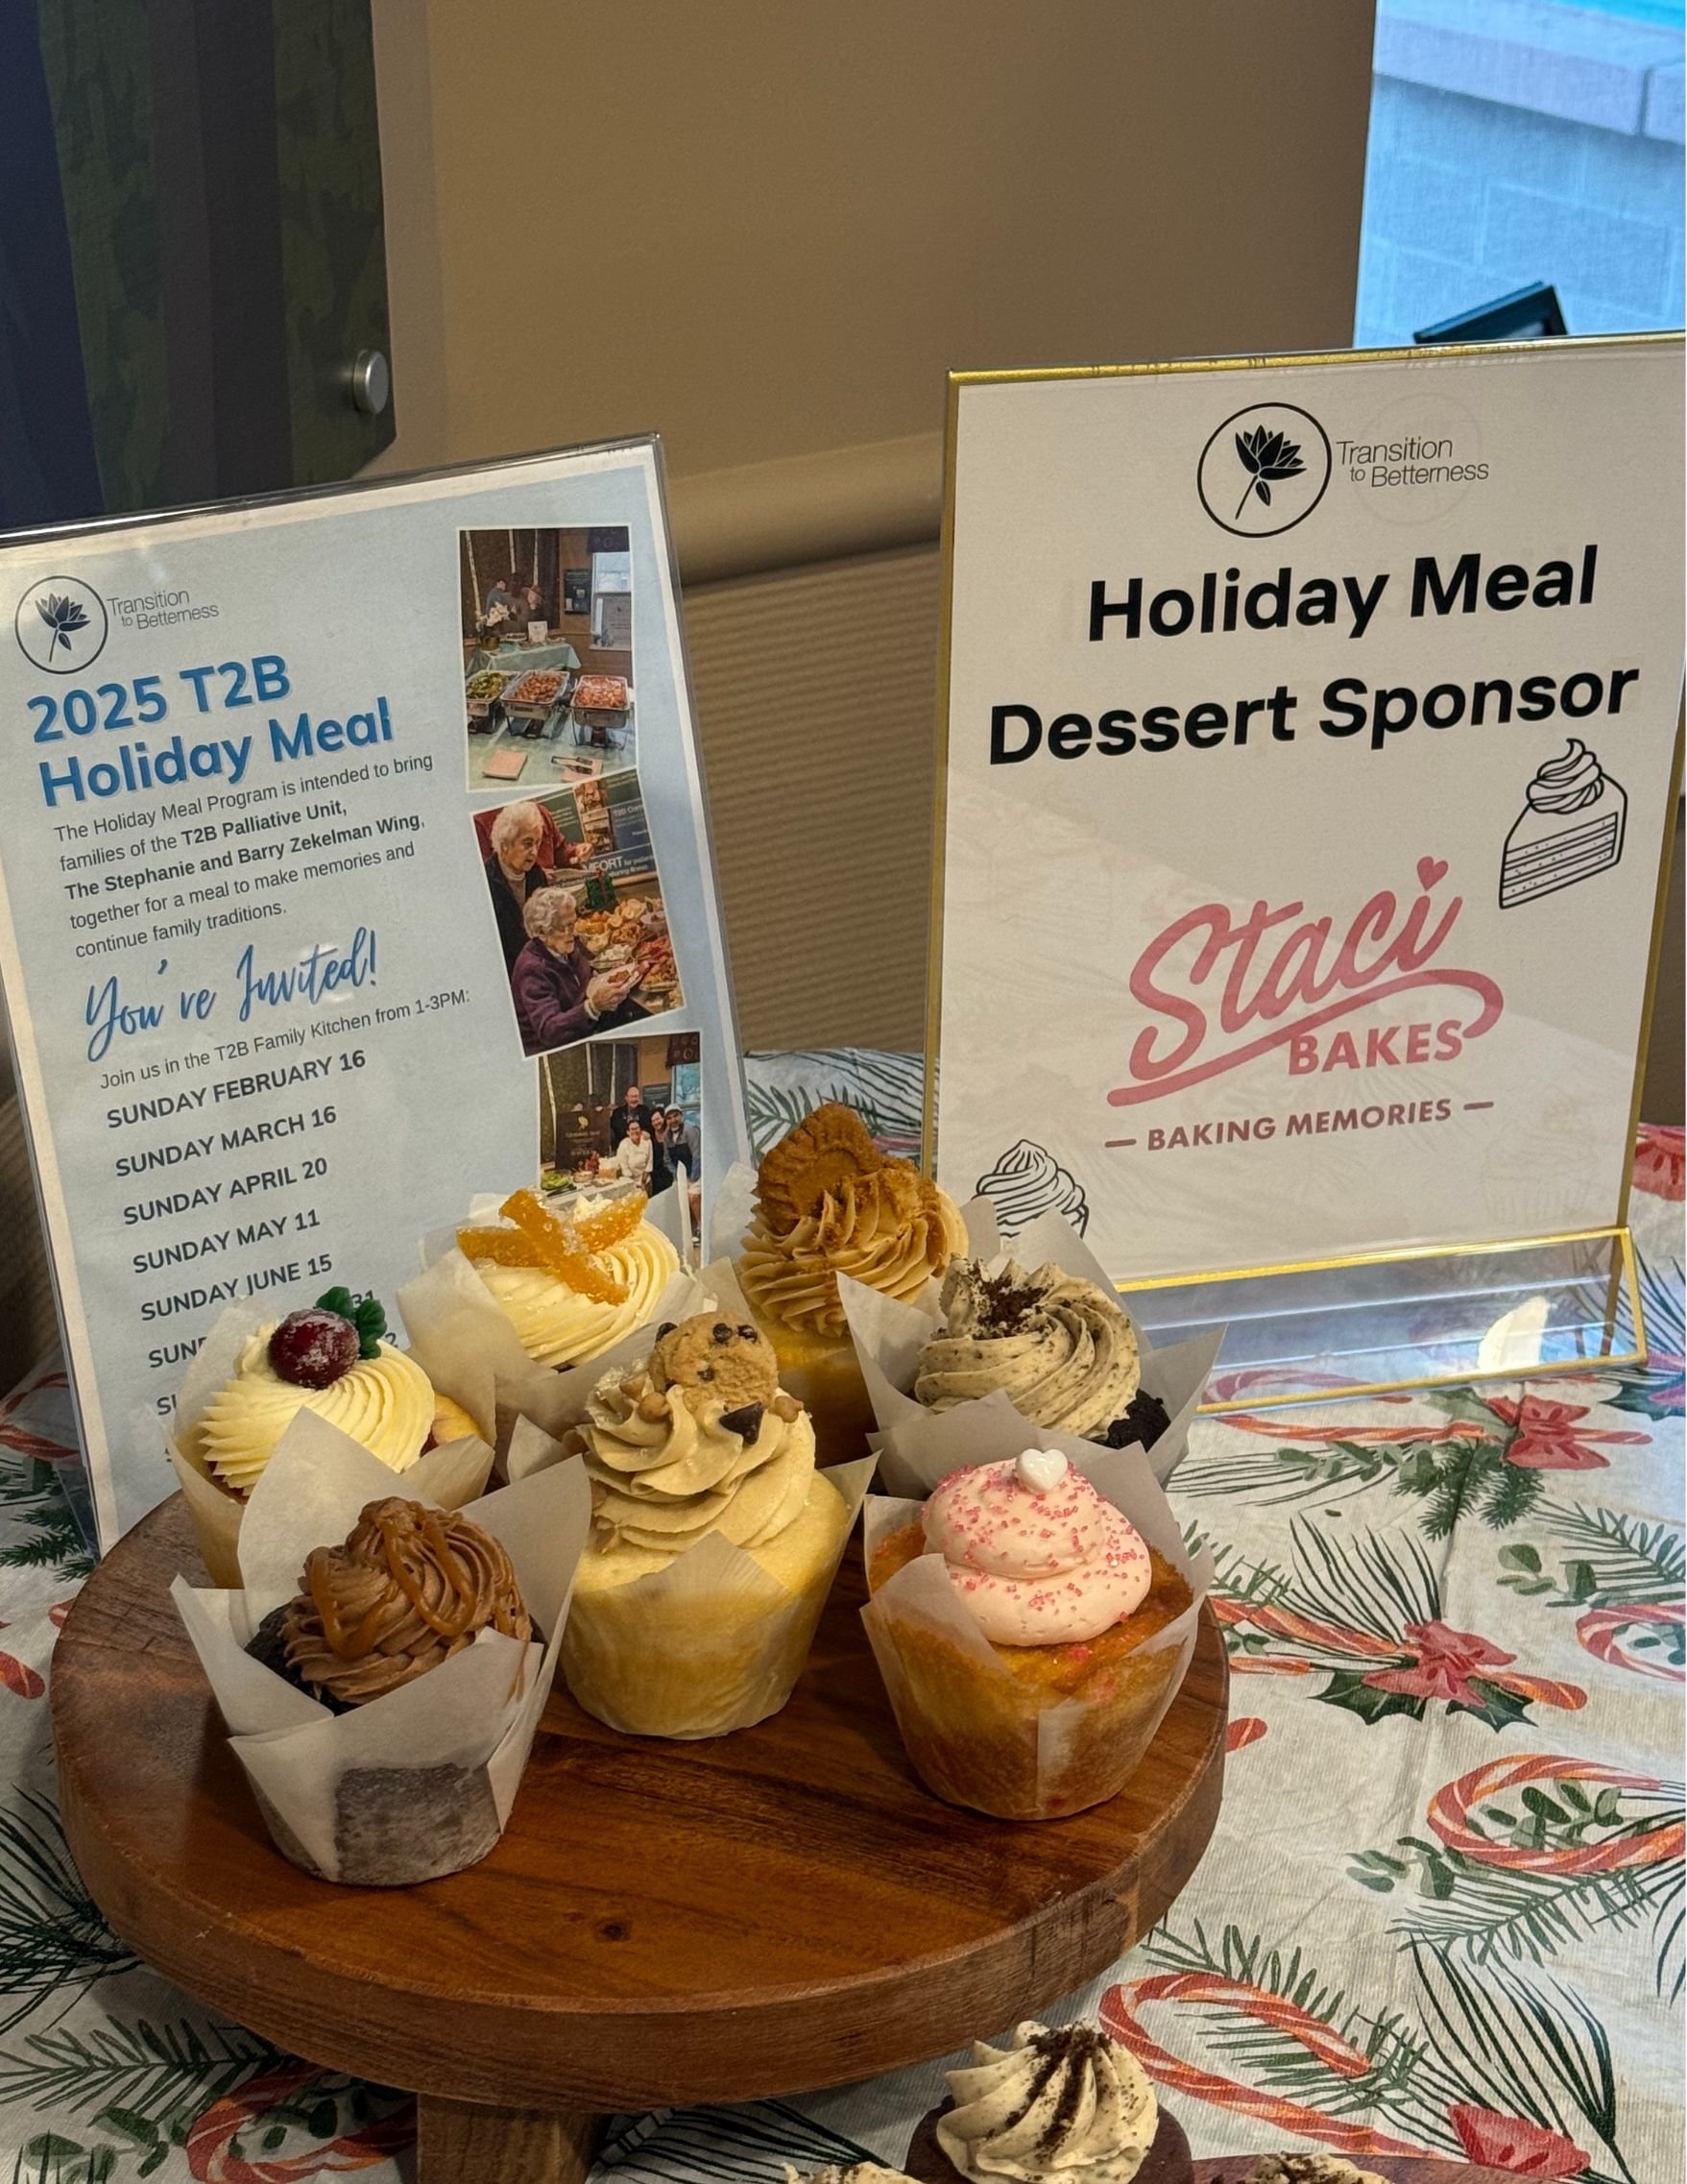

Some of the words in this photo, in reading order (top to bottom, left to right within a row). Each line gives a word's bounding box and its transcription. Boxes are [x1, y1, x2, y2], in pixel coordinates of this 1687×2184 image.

[1336, 435, 1454, 466] Transition
[1348, 466, 1366, 482] to
[1371, 463, 1490, 488] Betterness
[106, 589, 191, 617] Transition
[121, 615, 134, 627] to
[135, 603, 220, 630] Betterness
[1088, 567, 1391, 643] Holiday
[1410, 544, 1600, 619] Meal
[26, 675, 168, 743] 2025
[180, 654, 291, 713] T2B
[990, 685, 1298, 766] Dessert
[1318, 667, 1641, 751] Sponsor
[38, 736, 253, 809] Holiday
[268, 696, 394, 764] Meal
[53, 824, 89, 842] The
[93, 810, 157, 836] Holiday
[160, 797, 204, 821] Meal
[206, 786, 278, 812] Program
[281, 783, 297, 797] is
[300, 764, 370, 793] intended
[373, 764, 390, 778] to
[393, 755, 433, 774] bring
[59, 847, 126, 872] families
[130, 838, 146, 857] of
[150, 835, 178, 853] the
[180, 825, 218, 846] T2B
[221, 811, 302, 838] Palliative
[305, 799, 348, 820] Unit,
[63, 882, 100, 900] The
[104, 861, 196, 892] Stephanie
[199, 850, 234, 873] and
[237, 842, 285, 864] Barry
[289, 825, 374, 854] Zekelman
[375, 814, 425, 835] Wing,
[69, 902, 140, 930] together
[144, 896, 168, 913] for
[173, 894, 185, 908] a
[188, 881, 230, 905] meal
[233, 880, 251, 895] to
[253, 868, 299, 890] make
[302, 852, 382, 880] memories
[385, 840, 415, 861] and
[75, 932, 149, 959] continue
[152, 917, 202, 941] family
[205, 902, 287, 930] traditions.
[85, 959, 217, 1063] You've
[235, 926, 376, 1023] Invited!
[1129, 856, 1463, 1081] Staci
[100, 1069, 135, 1089] Join
[140, 1064, 161, 1080] us
[163, 1058, 181, 1075] in
[183, 1052, 210, 1070] the
[213, 1041, 250, 1061] T2B
[253, 1028, 306, 1054] Family
[310, 1014, 372, 1039] Kitchen
[374, 1005, 411, 1024] from
[415, 988, 470, 1015] 1-3PM:
[1288, 1019, 1464, 1076] BAKES
[107, 1086, 207, 1128] SUNDAY
[212, 1056, 333, 1104] FEBRUARY
[339, 1049, 366, 1072] 16
[1146, 1115, 1277, 1152] BAKING
[1285, 1097, 1453, 1138] MEMORIES
[115, 1135, 215, 1177] SUNDAY
[220, 1113, 305, 1152] MARCH
[311, 1105, 337, 1128] 16
[123, 1182, 223, 1225] SUNDAY
[229, 1166, 298, 1200] APRIL
[301, 1156, 327, 1180] 20
[133, 1229, 230, 1274] SUNDAY
[236, 1216, 288, 1247] MAY
[294, 1208, 321, 1231] 11
[140, 1277, 239, 1322] SUNDAY
[246, 1261, 301, 1297] JUNE
[307, 1252, 332, 1276] 15
[148, 1336, 208, 1369] SUN
